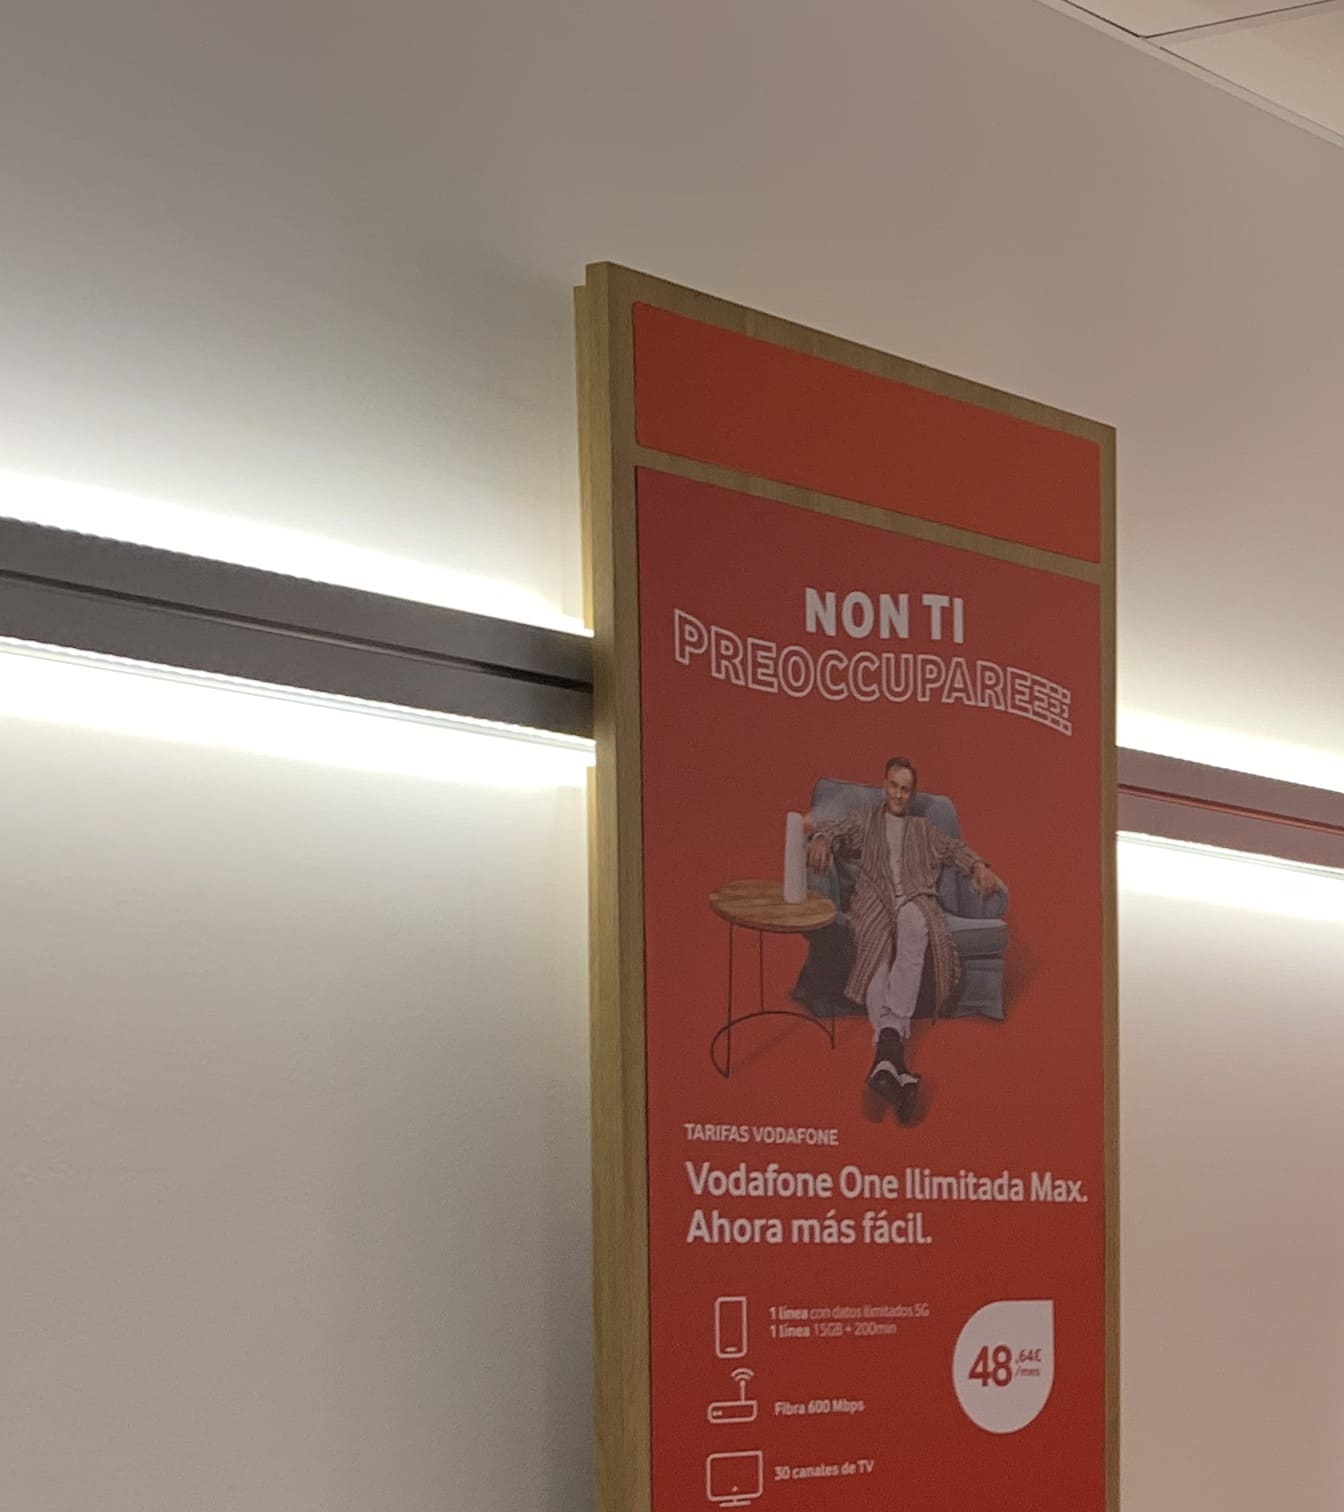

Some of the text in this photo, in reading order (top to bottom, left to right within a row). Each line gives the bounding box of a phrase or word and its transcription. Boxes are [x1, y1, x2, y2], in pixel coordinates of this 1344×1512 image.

[805, 587, 965, 644] NON TI
[684, 1123, 839, 1145] TARIFAS VODAFONE
[685, 1161, 1088, 1203] Vodafone One Ilimitada Max.
[686, 1208, 933, 1244] Ahora más fácil.
[769, 1306, 777, 1320] 1
[769, 1324, 777, 1338] 1
[968, 1344, 1013, 1388] 48
[775, 1401, 806, 1415] Fibra
[792, 1463, 840, 1479] canales
[841, 1462, 856, 1475] de
[856, 1459, 875, 1474] TV
